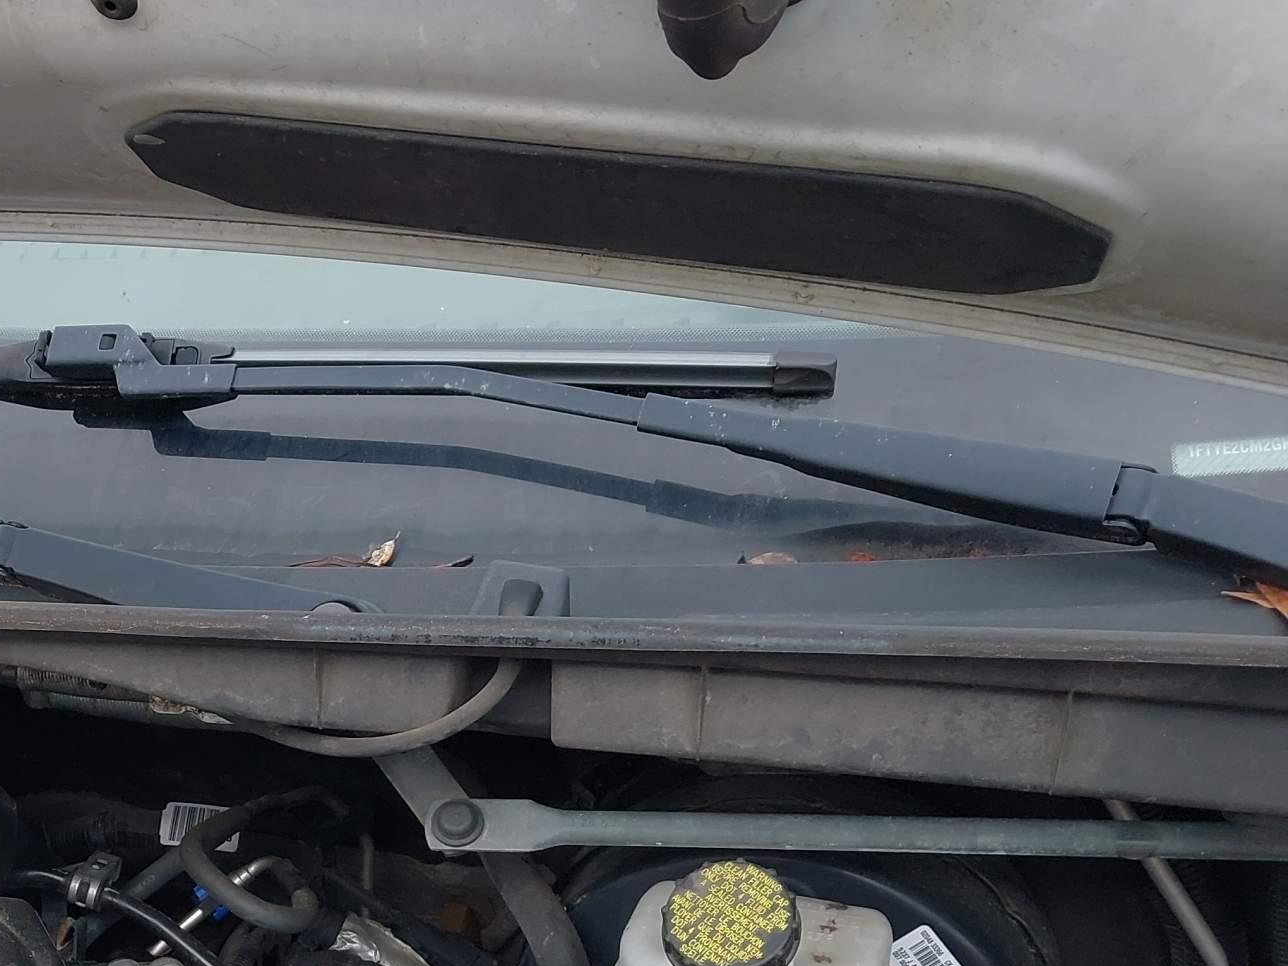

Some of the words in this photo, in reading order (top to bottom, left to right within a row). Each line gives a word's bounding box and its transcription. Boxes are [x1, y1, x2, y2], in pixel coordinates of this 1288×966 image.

[700, 878, 708, 886] A
[708, 883, 737, 906] SEALED
[700, 867, 722, 885] ONLY
[720, 881, 737, 895] DOT
[744, 898, 767, 916] FLUID
[766, 912, 789, 931] FROM
[711, 863, 739, 885] BEFORE
[774, 906, 792, 922] USE
[723, 861, 749, 881] CLEAN
[747, 876, 773, 898] FILLER
[772, 894, 790, 909] CAP
[669, 902, 698, 925] PLOYER
[697, 921, 714, 936] QUE
[712, 932, 726, 944] DU
[724, 941, 753, 964] LIQUIDE
[671, 914, 688, 929] DOT
[687, 926, 696, 935] 4
[695, 932, 737, 964] PROVENANT
[683, 889, 720, 917] NETTOYER
[718, 914, 732, 926] LE
[731, 922, 765, 950] BOUCHON
[693, 907, 706, 919] DE
[704, 915, 716, 926] LE
